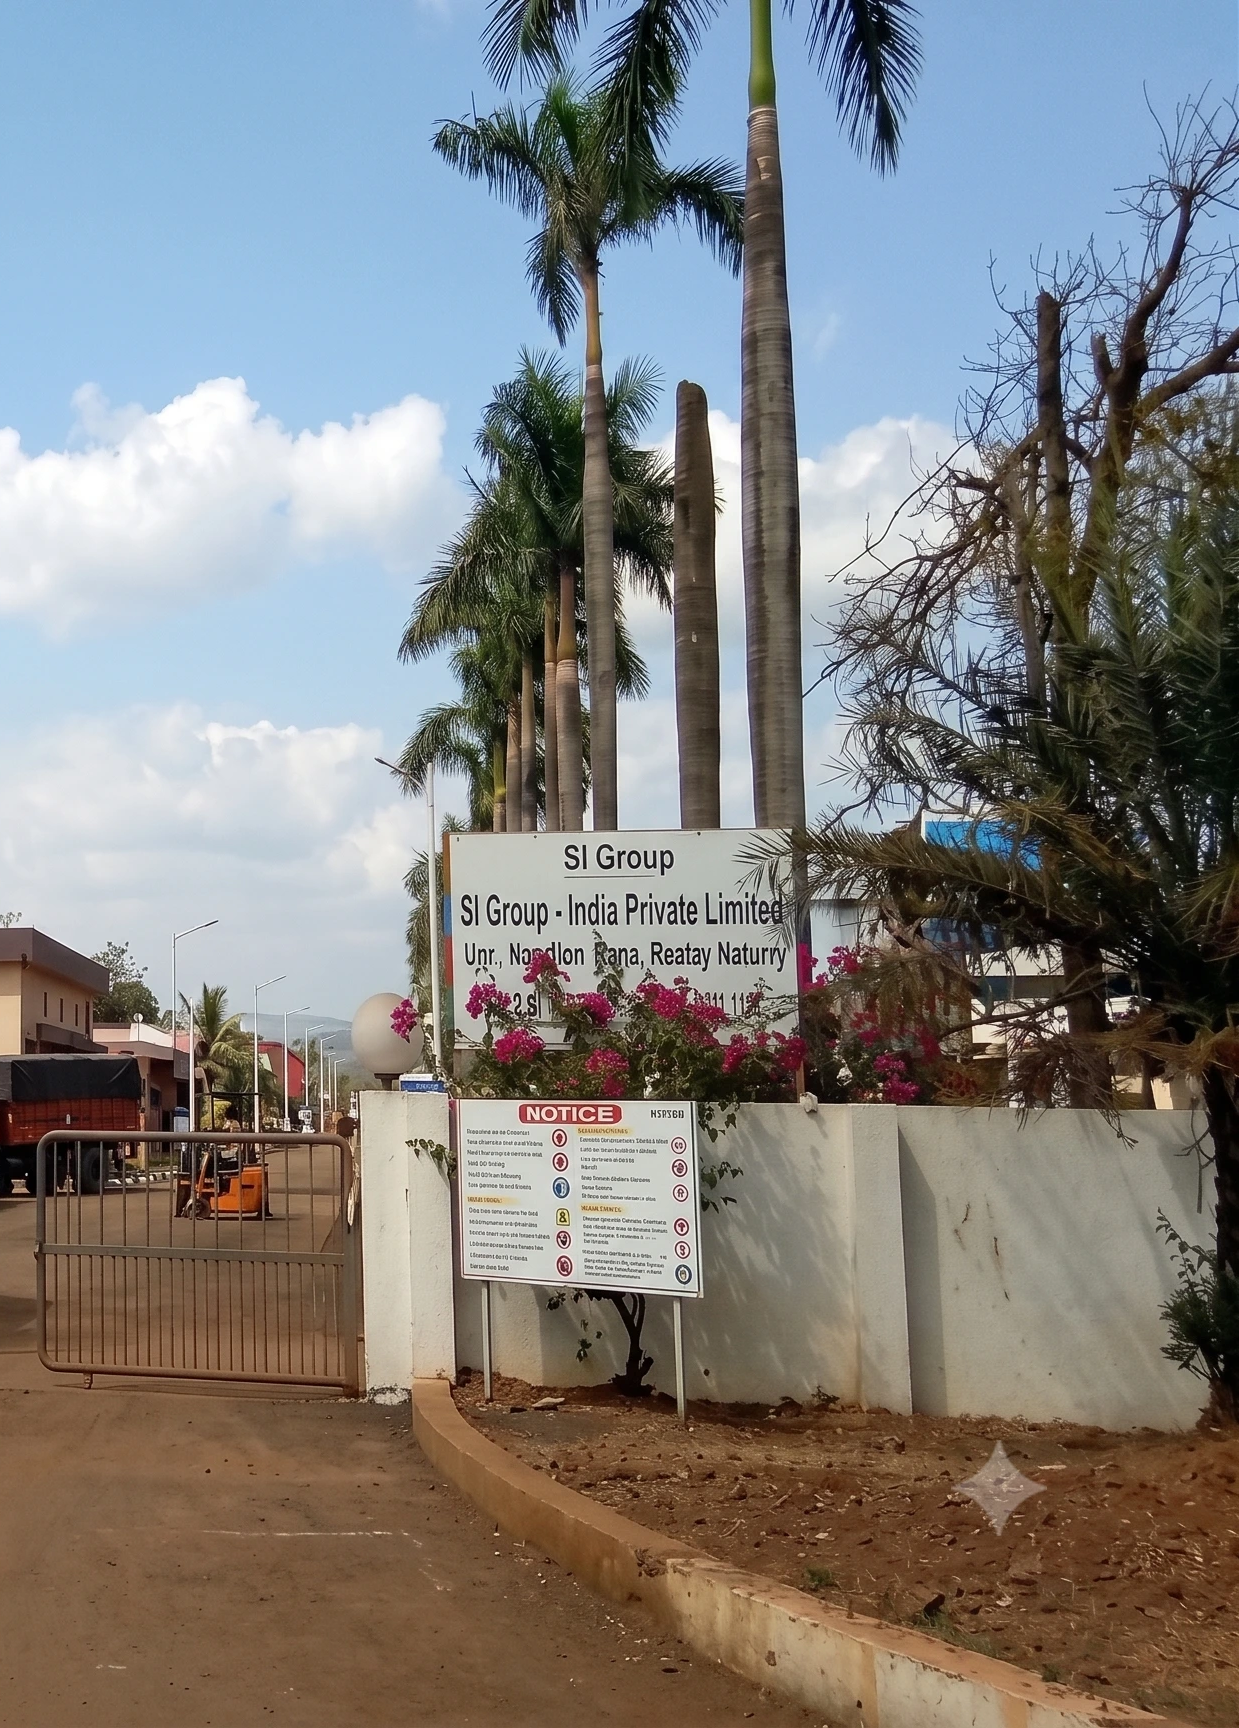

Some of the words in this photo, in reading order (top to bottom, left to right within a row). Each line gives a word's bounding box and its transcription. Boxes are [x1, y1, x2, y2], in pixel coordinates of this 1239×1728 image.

[564, 844, 587, 870] SI
[596, 843, 675, 876] Group
[460, 894, 479, 926] SI
[486, 894, 549, 934] Group
[568, 893, 618, 926] India
[625, 892, 698, 925] Private
[705, 891, 783, 925] Limited
[650, 941, 712, 972] Reatay
[526, 1106, 614, 1122] NOTICE
